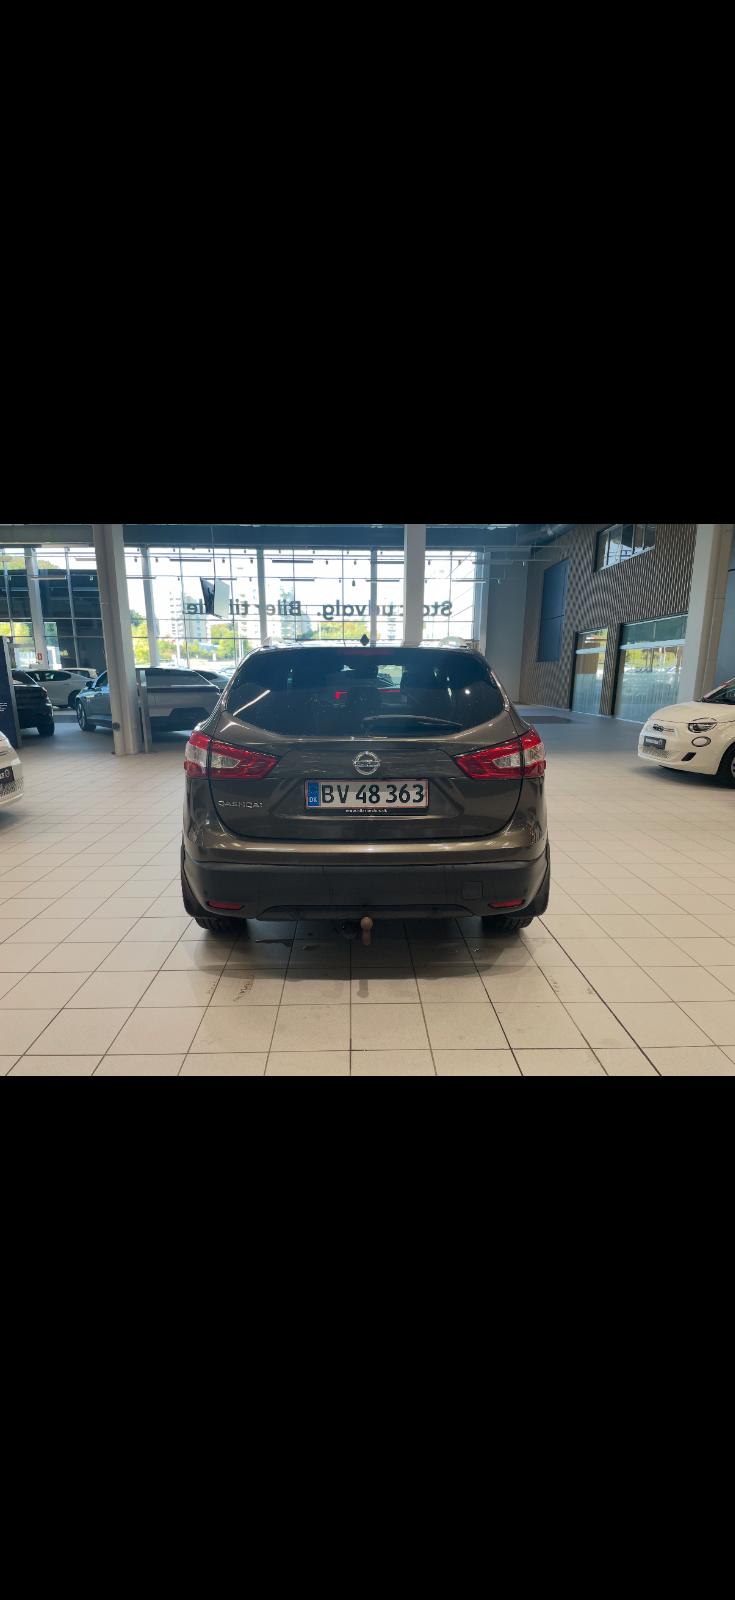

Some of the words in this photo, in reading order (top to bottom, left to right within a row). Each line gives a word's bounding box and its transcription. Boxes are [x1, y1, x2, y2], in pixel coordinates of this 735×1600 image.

[321, 784, 350, 804] BV
[355, 784, 380, 804] 48
[385, 783, 424, 804] 363
[218, 800, 263, 809] QASHQAI
